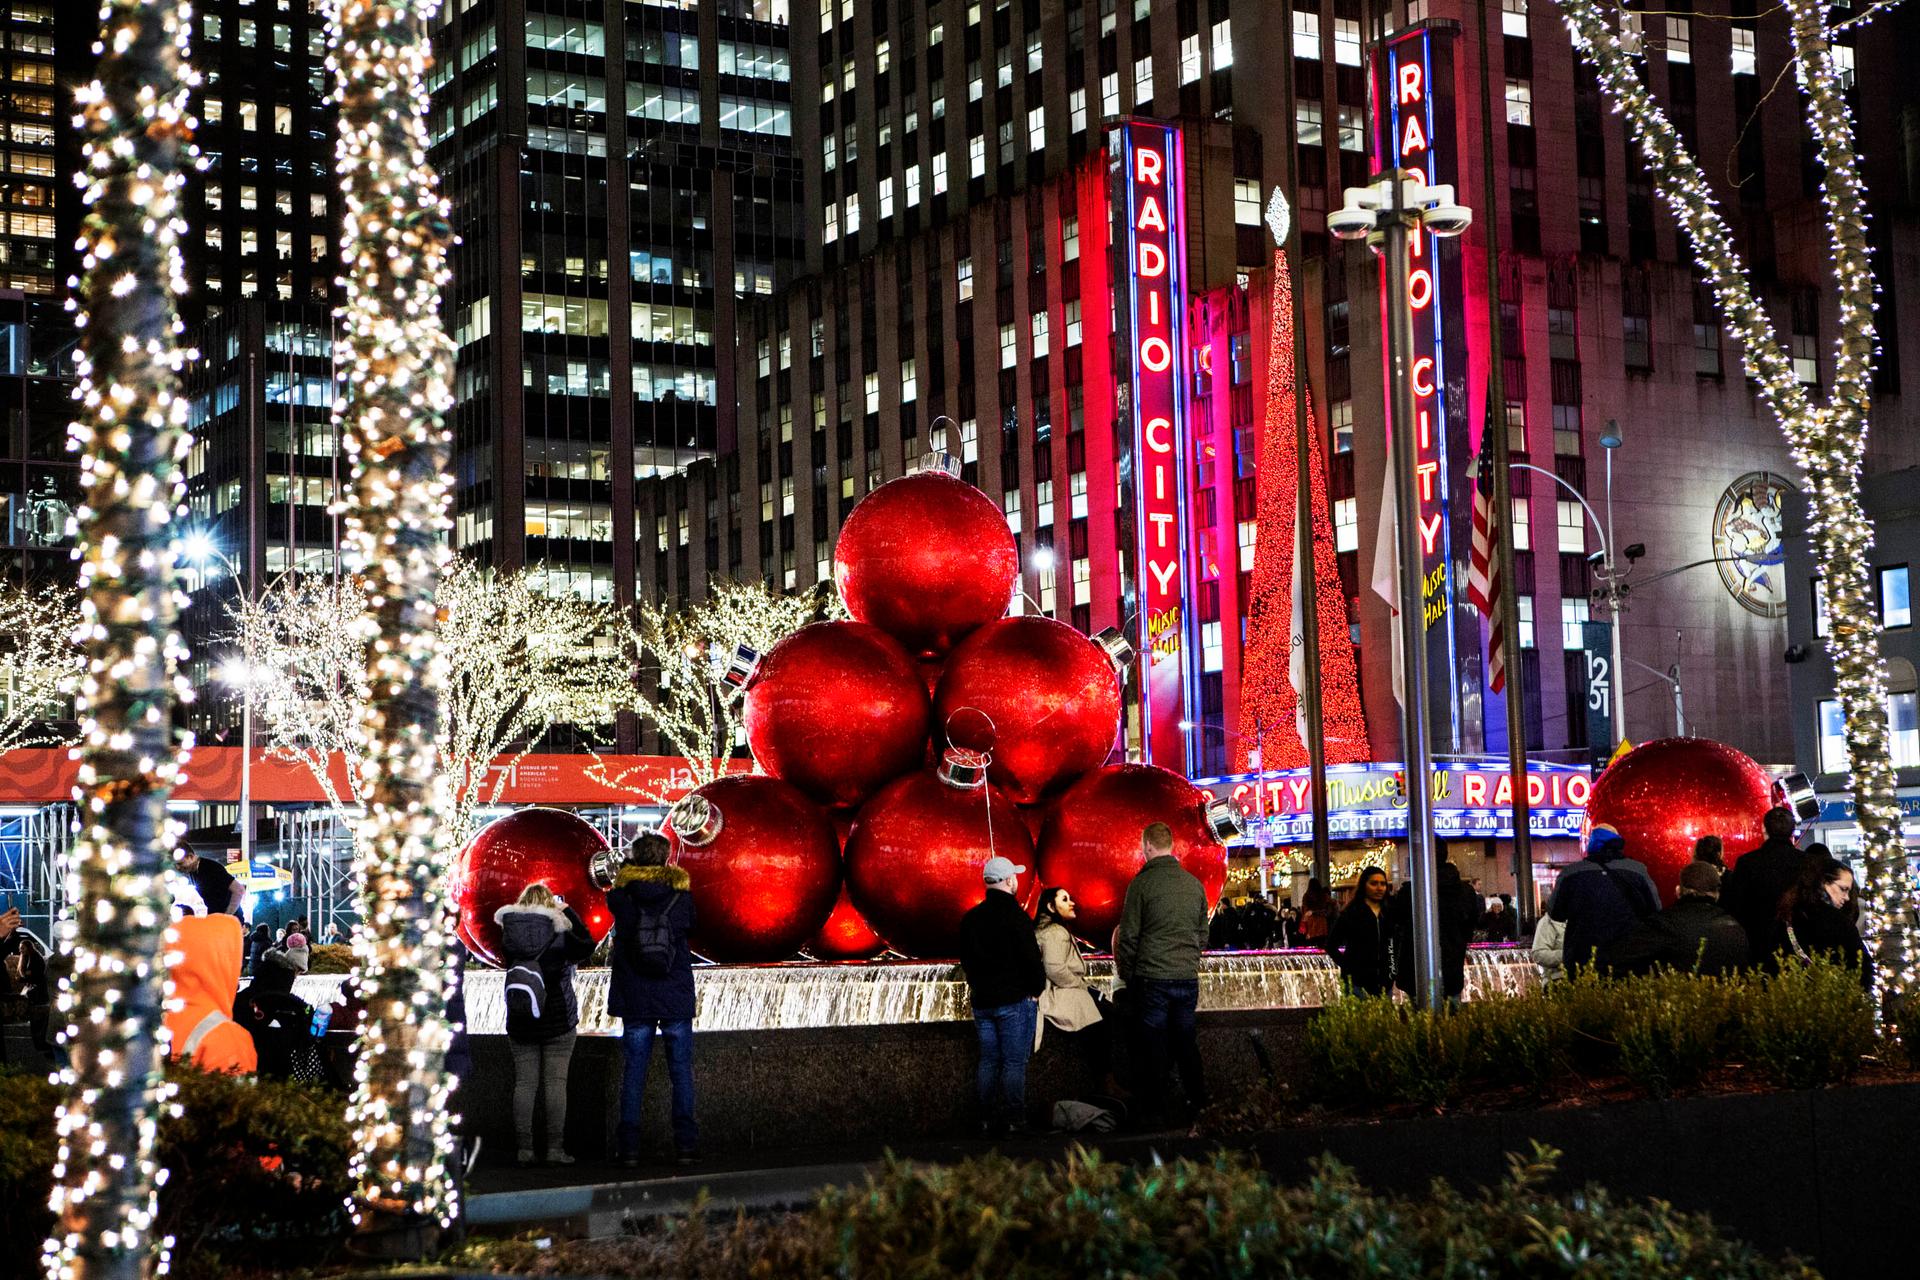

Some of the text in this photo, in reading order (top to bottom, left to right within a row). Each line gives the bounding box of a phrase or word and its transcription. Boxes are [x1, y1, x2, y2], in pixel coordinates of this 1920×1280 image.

[1137, 148, 1170, 372] RADIO
[1413, 357, 1441, 553] CITY
[1145, 418, 1177, 595] CITY
[1148, 606, 1179, 640] MUSIC
[1424, 594, 1447, 631] HALL
[1233, 777, 1309, 815] CITY
[1327, 776, 1395, 810] Music
[1465, 774, 1591, 806] RADIO
[1291, 820, 1313, 834] CITY
[1328, 816, 1405, 832] OCKETTES
[1434, 816, 1460, 829] NOW
[1475, 816, 1497, 829] JAN
[1529, 816, 1549, 829] GET
